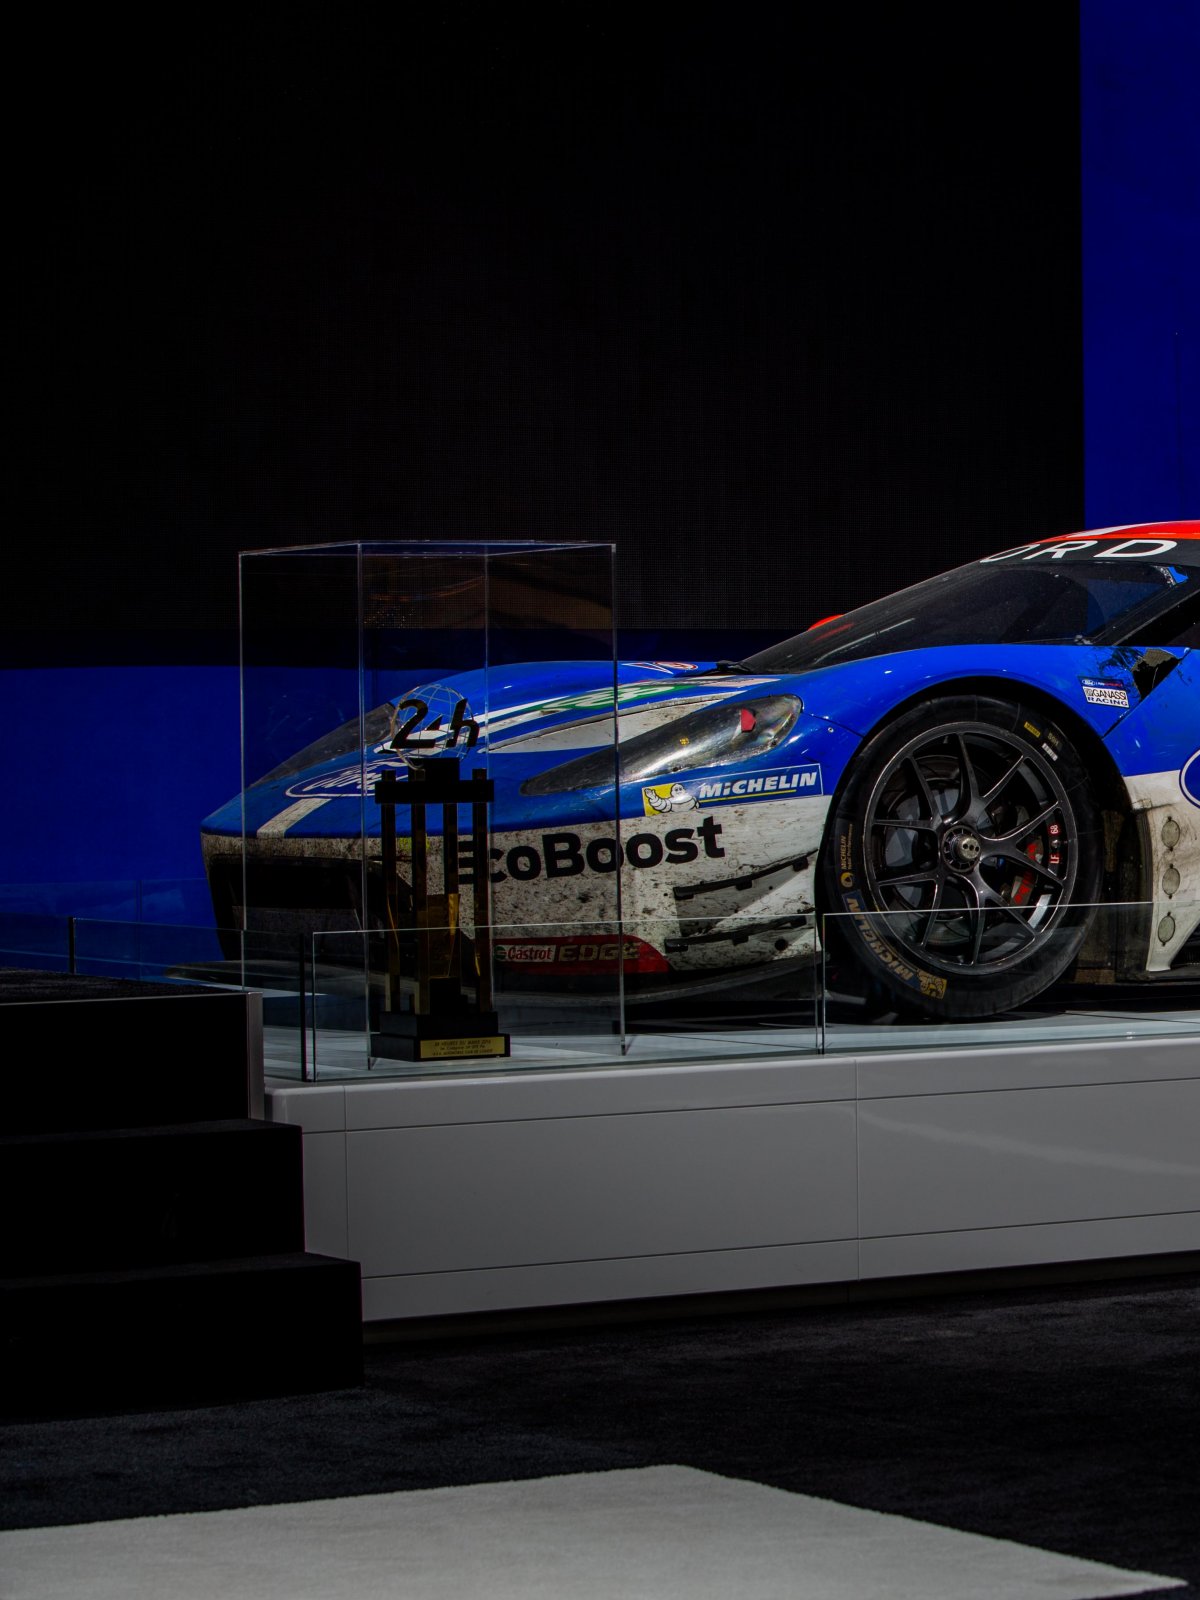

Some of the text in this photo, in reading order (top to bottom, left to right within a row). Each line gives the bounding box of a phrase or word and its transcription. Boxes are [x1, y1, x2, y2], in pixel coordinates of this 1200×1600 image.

[1087, 696, 1128, 706] RACING
[507, 942, 641, 962] Castrol EDGE
